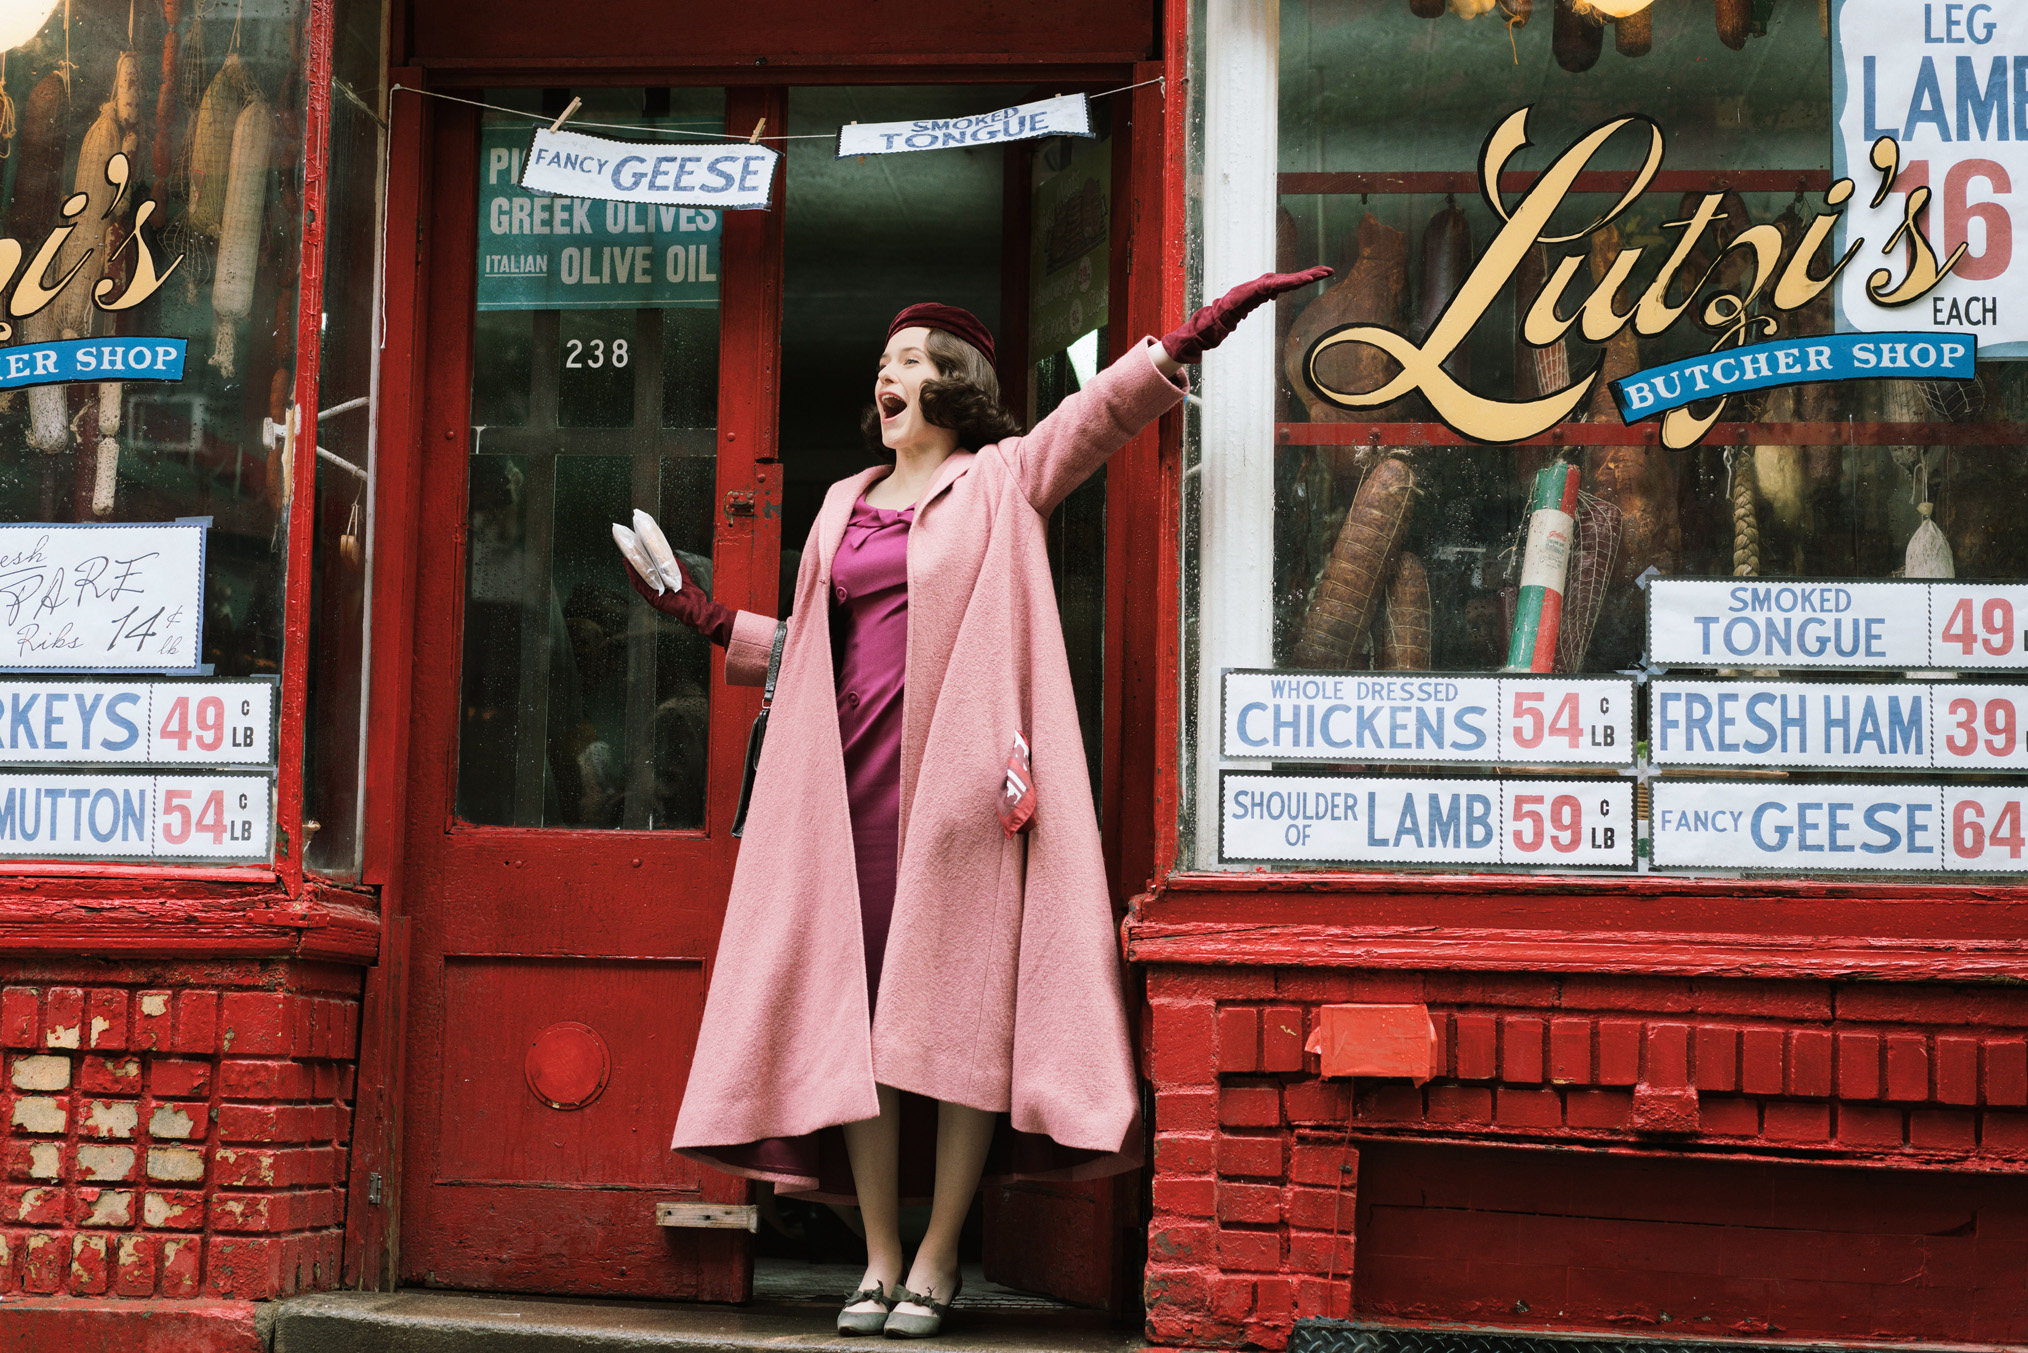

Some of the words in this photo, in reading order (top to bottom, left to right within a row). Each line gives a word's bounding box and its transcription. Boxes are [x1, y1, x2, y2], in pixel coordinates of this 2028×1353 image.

[1924, 4, 1997, 45] LEG
[880, 112, 1049, 150] TONGUE
[911, 107, 1018, 133] SMOKED
[535, 148, 609, 175] FANCY
[611, 155, 766, 194] GEESE
[490, 196, 593, 235] GREEK
[605, 200, 717, 234] OLIVES
[485, 254, 547, 273] ITALIAN
[560, 246, 652, 285] OLIVE
[666, 244, 717, 283] OIL
[1933, 296, 1997, 326] EACH
[0, 350, 59, 380] ER
[76, 346, 178, 371] SHOP
[566, 338, 628, 368] 238
[1625, 347, 1833, 410] BUTCHER
[1853, 343, 1965, 371] SHOP
[1728, 586, 1852, 613] SMOKED
[17, 622, 84, 658] Ribs
[106, 605, 166, 652] 14
[157, 635, 183, 655] lb
[1694, 616, 1887, 658] TONGUE
[1941, 597, 2015, 657] 49
[1270, 680, 1344, 700] WHOLE
[1357, 682, 1459, 702] DRESSED
[0, 692, 142, 752] KEYS
[159, 696, 226, 752] 49
[232, 726, 255, 748] LB
[1236, 701, 1488, 752] CHICKENS
[1512, 691, 1585, 750] 54
[1591, 724, 1616, 747] LB
[1659, 692, 1807, 754] FRESH
[1823, 694, 1924, 756] HAM
[1945, 697, 2017, 758] 39
[0, 787, 146, 844] MUTTON
[162, 789, 228, 846] 54
[1231, 790, 1359, 823] SHOULDER
[1367, 791, 1494, 850] LAMB
[1512, 794, 1583, 854] 59
[229, 820, 252, 843] LB
[1284, 823, 1313, 848] OF
[1591, 826, 1616, 850] LB
[1661, 809, 1744, 833] FANCY
[1750, 801, 1934, 855] GEESE
[1952, 799, 2026, 860] 64
